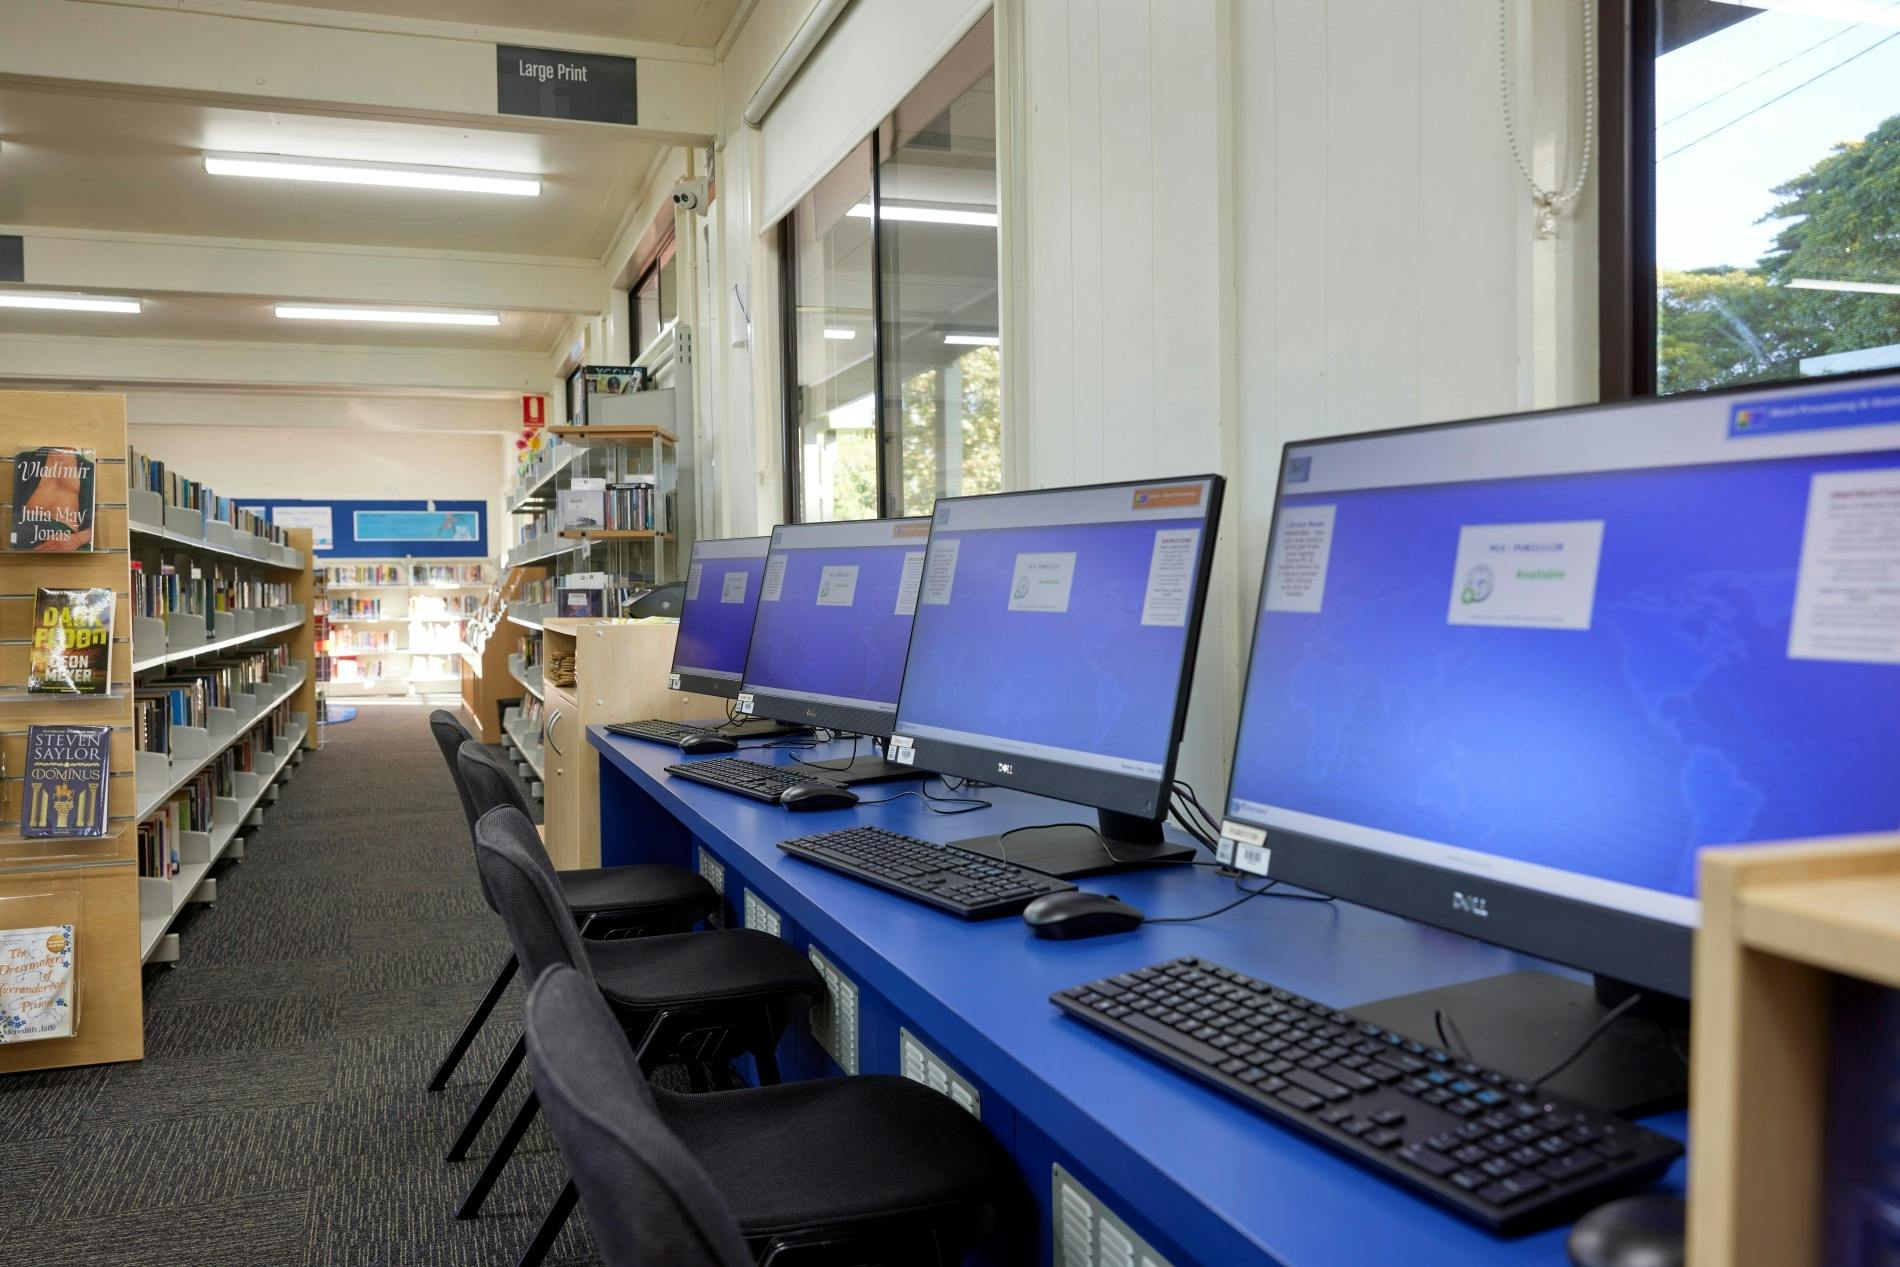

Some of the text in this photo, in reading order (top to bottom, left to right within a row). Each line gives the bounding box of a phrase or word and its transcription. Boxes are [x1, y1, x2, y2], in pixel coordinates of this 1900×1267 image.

[519, 59, 588, 82] Large Print
[18, 460, 91, 482] Vladimir
[18, 504, 89, 527] Julia May
[30, 524, 71, 544] Jonas
[35, 733, 100, 747] STEVEN
[34, 747, 101, 760] SAYLOR
[31, 767, 100, 781] DOMINUS
[9, 947, 28, 959] The
